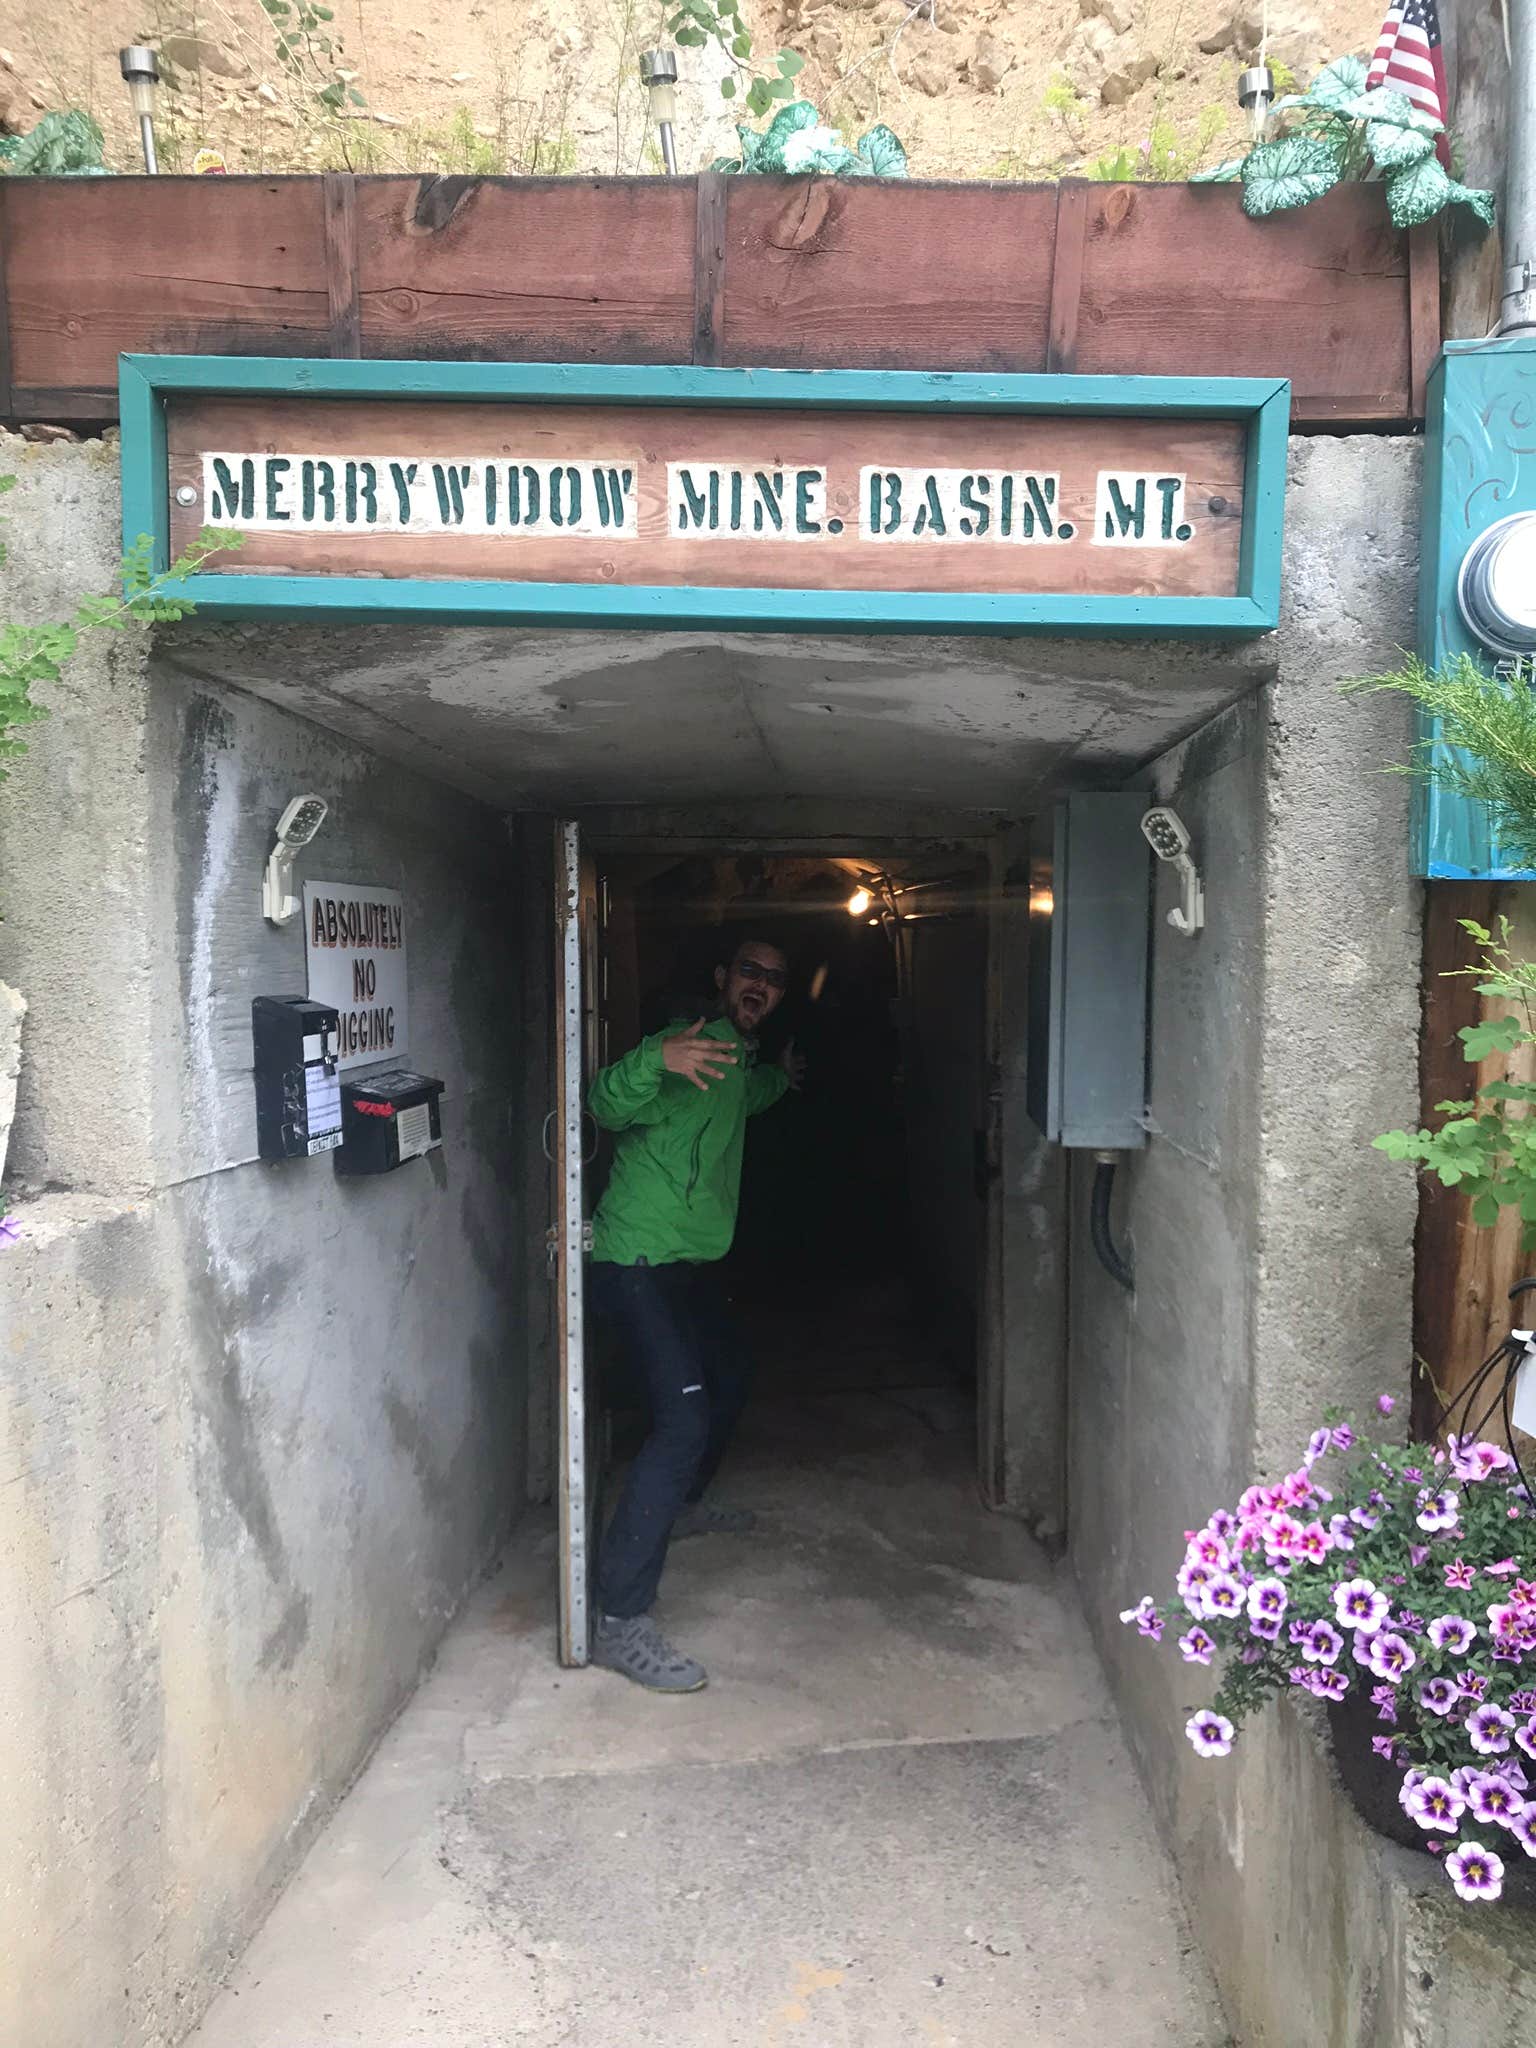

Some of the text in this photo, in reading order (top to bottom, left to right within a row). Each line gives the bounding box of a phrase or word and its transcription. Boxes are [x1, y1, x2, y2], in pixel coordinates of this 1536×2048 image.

[678, 469, 844, 535] MINE.
[870, 472, 1074, 540] BASIN.
[1105, 477, 1193, 542] MT.
[312, 896, 402, 948] ABSOLUTELY
[352, 958, 377, 1001] NO
